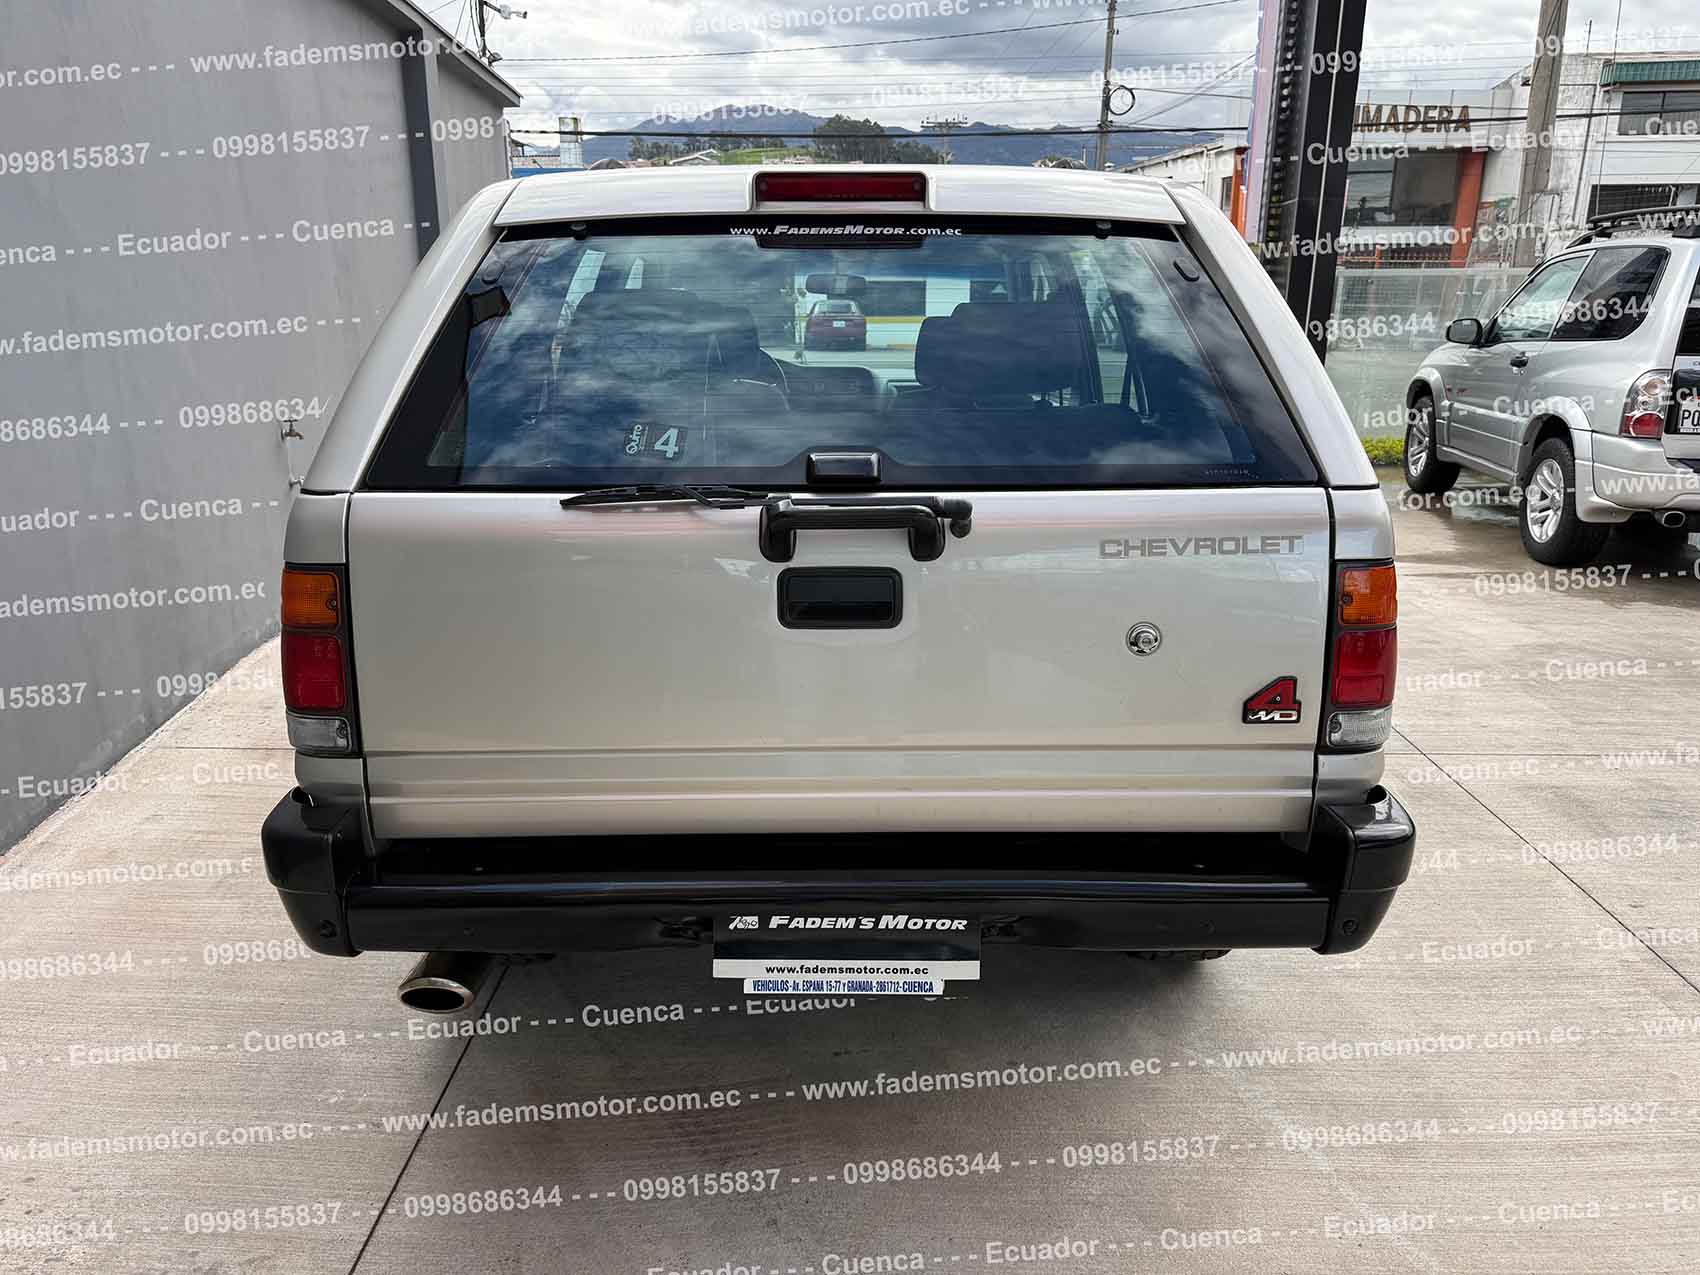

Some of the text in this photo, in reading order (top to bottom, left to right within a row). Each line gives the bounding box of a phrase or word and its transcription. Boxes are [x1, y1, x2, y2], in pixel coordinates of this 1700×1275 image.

[655, 427, 679, 458] 4
[1099, 535, 1304, 560] CHEVROLET
[878, 915, 968, 931] MOTOR
[765, 964, 929, 976] www.fademsmotor.com.ec
